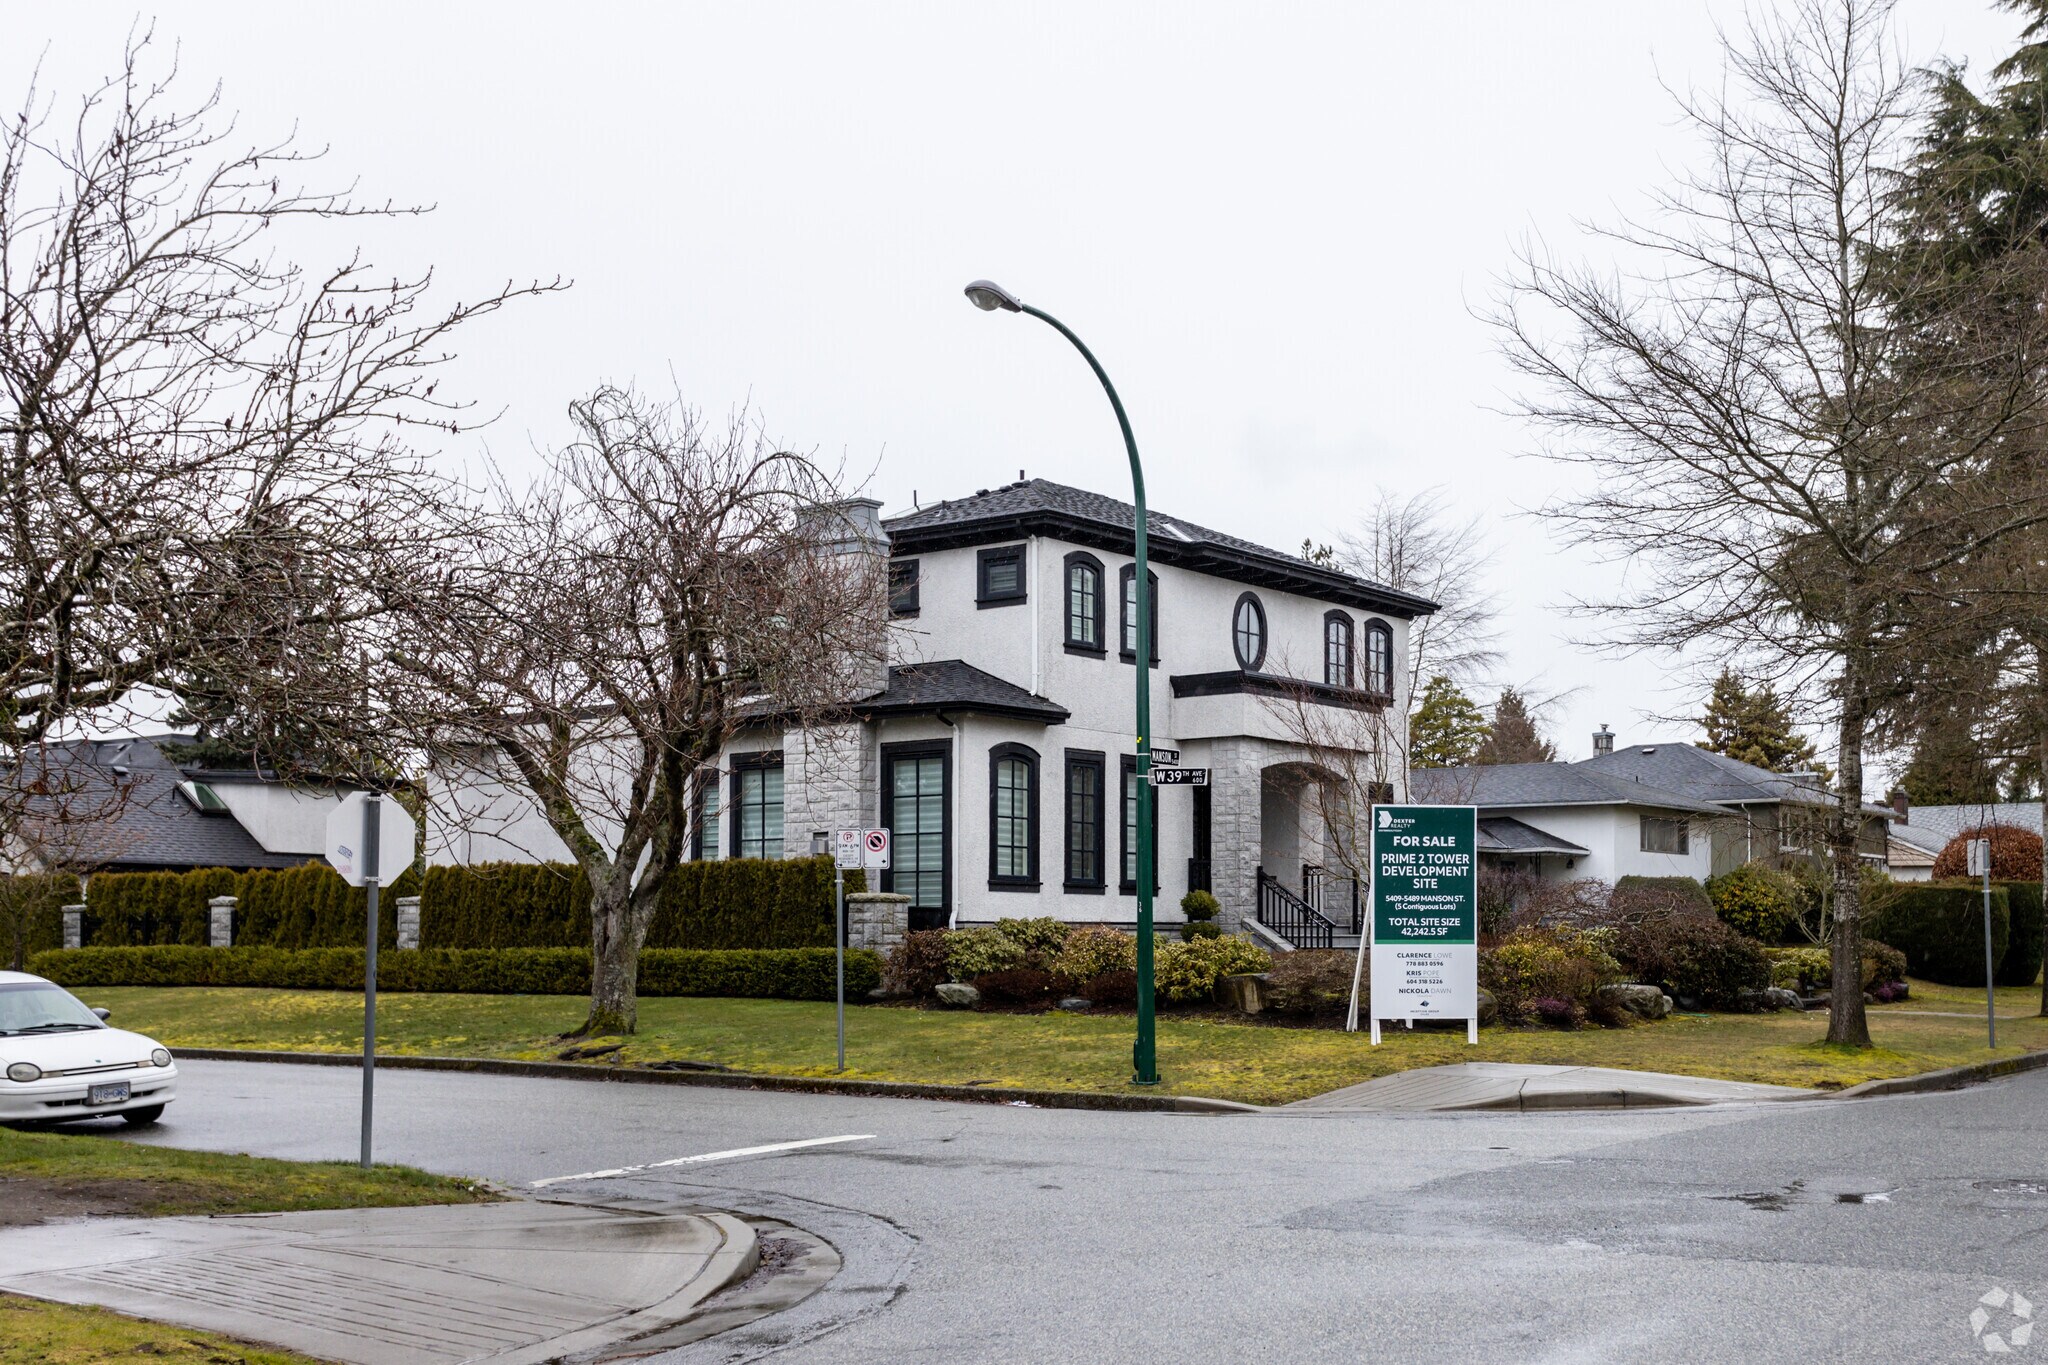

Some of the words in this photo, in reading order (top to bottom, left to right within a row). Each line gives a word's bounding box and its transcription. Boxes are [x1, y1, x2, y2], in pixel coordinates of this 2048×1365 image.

[1151, 750, 1172, 763] MANSON
[1156, 770, 1166, 782] W
[1393, 836, 1420, 847] FOR
[1422, 836, 1456, 847] SALE
[1381, 854, 1416, 864] PRIME
[1418, 854, 1425, 864] 2
[1427, 854, 1470, 864] TOWER
[1382, 866, 1469, 877] DEVELOPMENT
[1413, 878, 1438, 889] SITE
[1402, 903, 1439, 911] Contiguous
[1388, 918, 1420, 926] TOTAL
[1420, 918, 1440, 926] SITE
[1441, 918, 1461, 926] SIZE
[1401, 928, 1436, 937] 42,242.5
